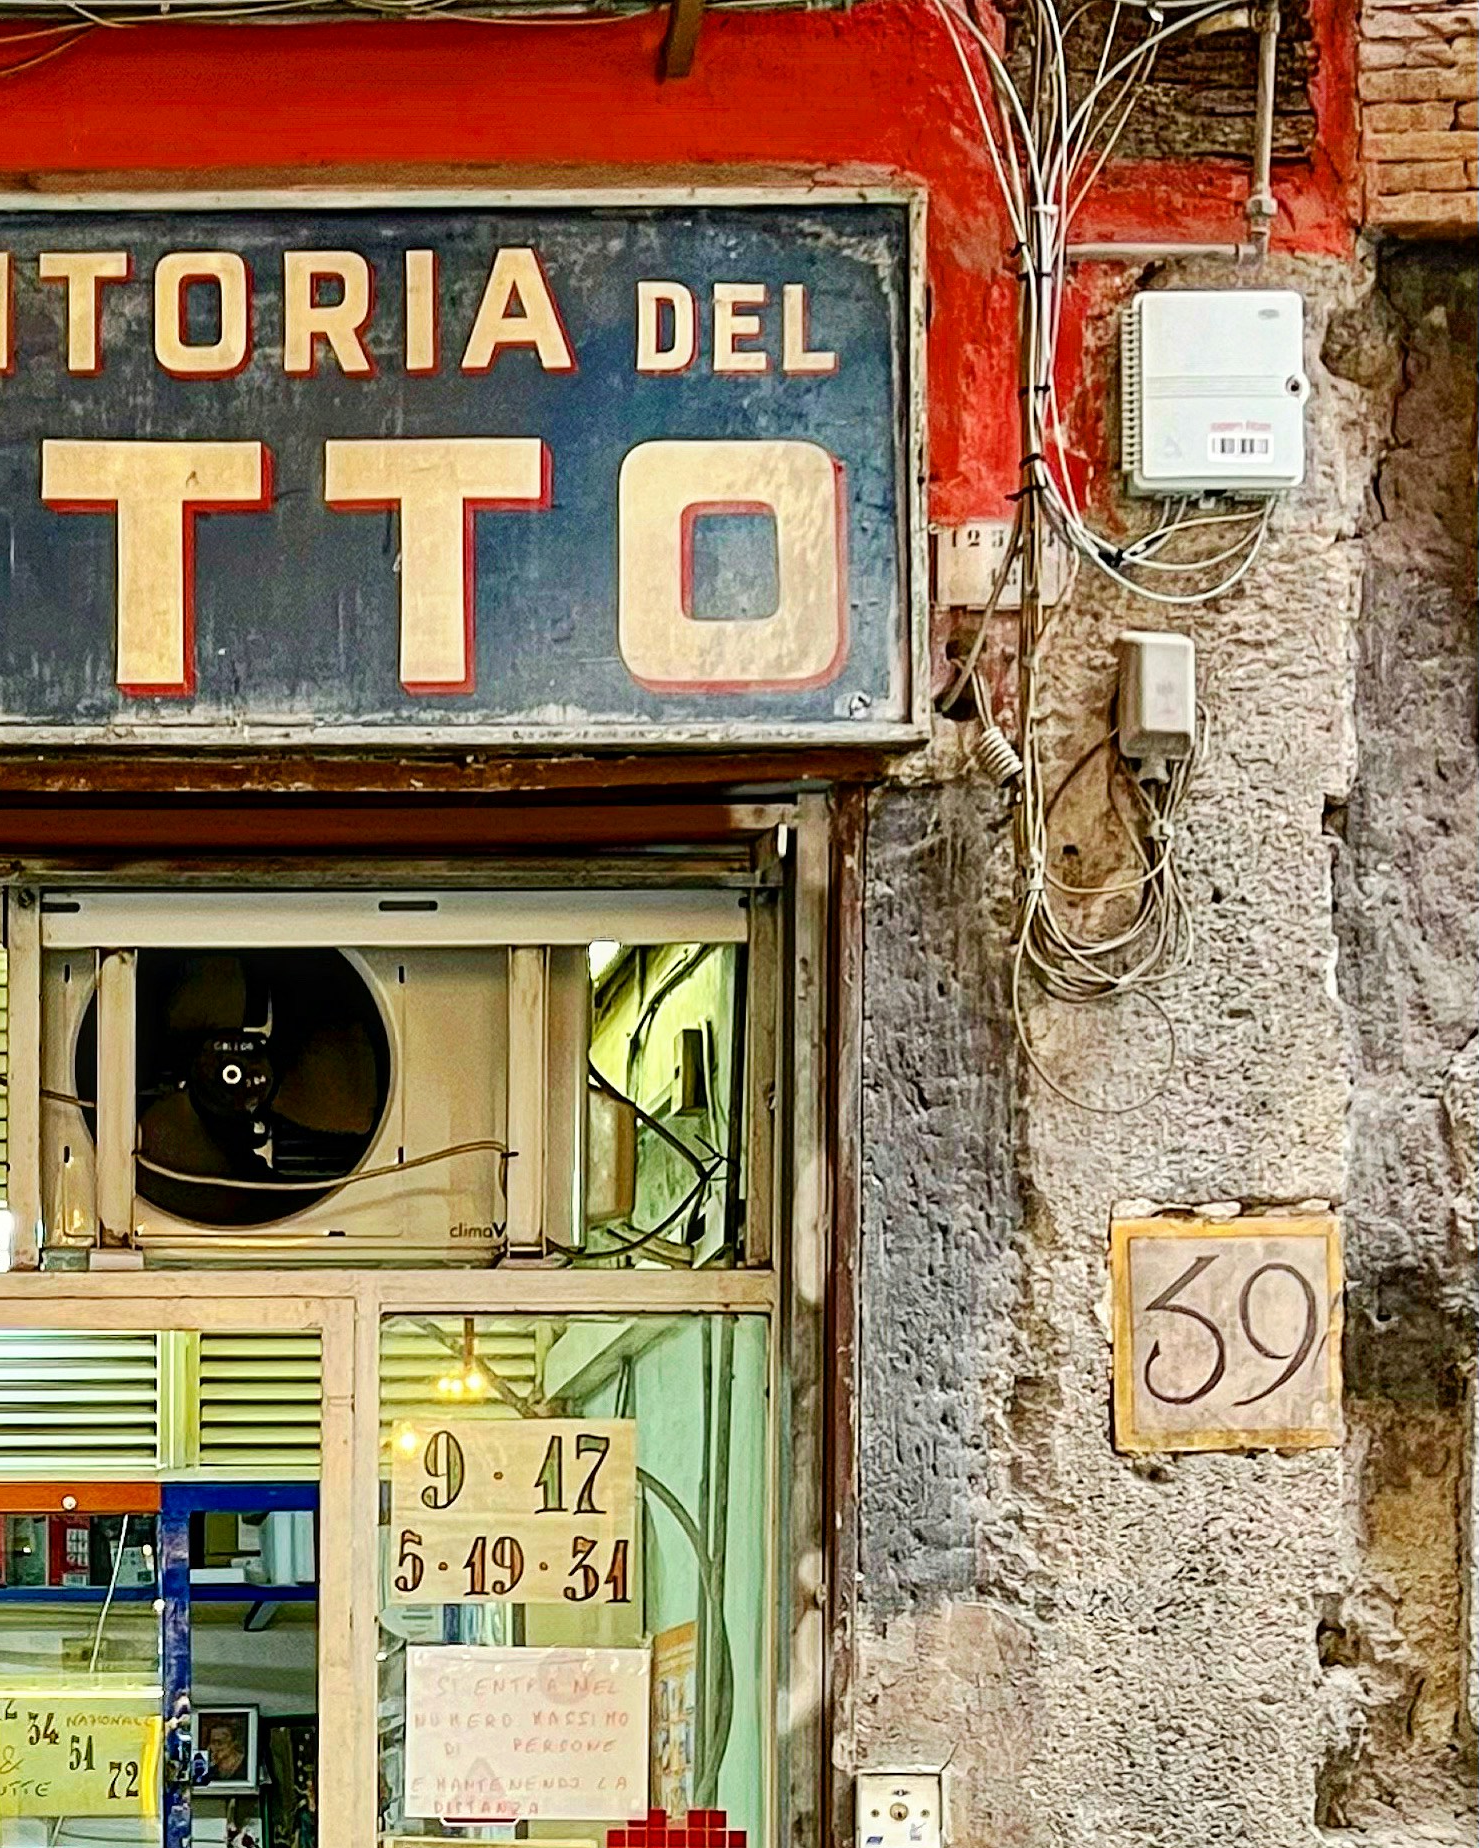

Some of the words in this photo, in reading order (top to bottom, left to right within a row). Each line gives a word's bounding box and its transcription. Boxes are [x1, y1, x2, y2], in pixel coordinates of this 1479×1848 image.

[634, 280, 839, 376] DEL
[1143, 1253, 1318, 1407] 39
[421, 1430, 465, 1510] 9
[534, 1434, 611, 1515] 17
[394, 1529, 424, 1593] 5
[463, 1536, 525, 1596] 19
[563, 1536, 631, 1603] 31
[107, 1760, 139, 1799] 72
